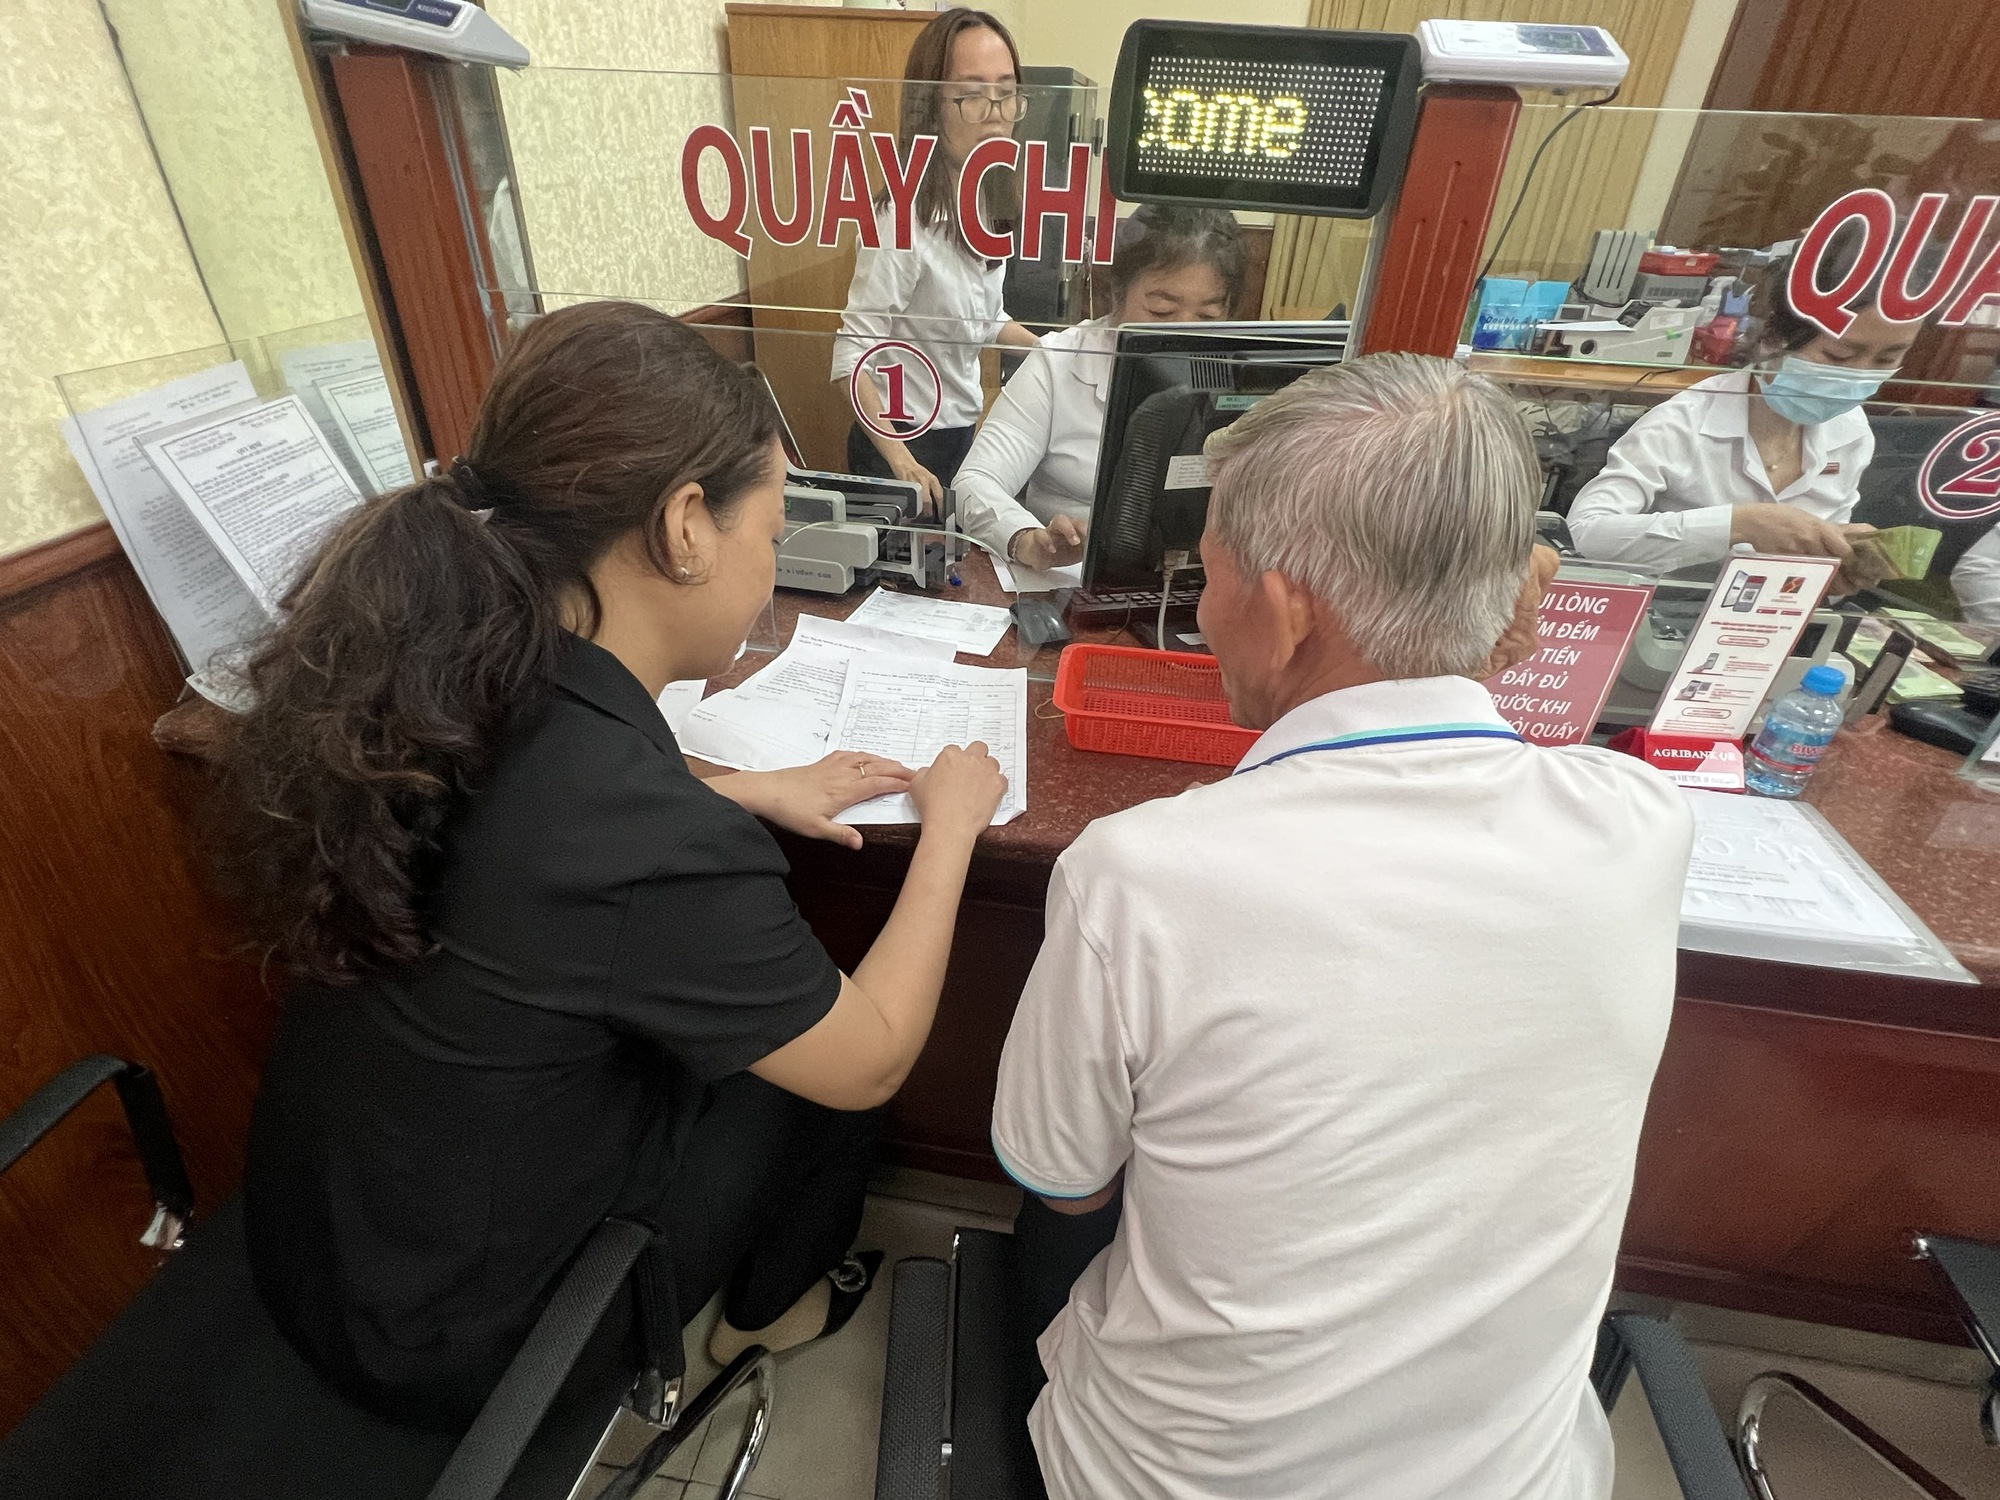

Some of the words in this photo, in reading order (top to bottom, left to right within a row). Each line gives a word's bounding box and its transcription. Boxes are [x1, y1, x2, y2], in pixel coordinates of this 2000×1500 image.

[681, 86, 939, 260] QUẦY
[957, 136, 1117, 266] CHI
[876, 362, 916, 423] 1
[1538, 593, 1556, 609] UI
[1555, 592, 1609, 614] LÒNG
[1555, 619, 1600, 642] ĐẾM
[1538, 670, 1569, 690] ĐỦ
[1490, 693, 1541, 713] RƯỚC
[1538, 701, 1572, 715] KHI
[1652, 748, 1720, 761] AGRIBANK
[1719, 751, 1737, 763] QR
